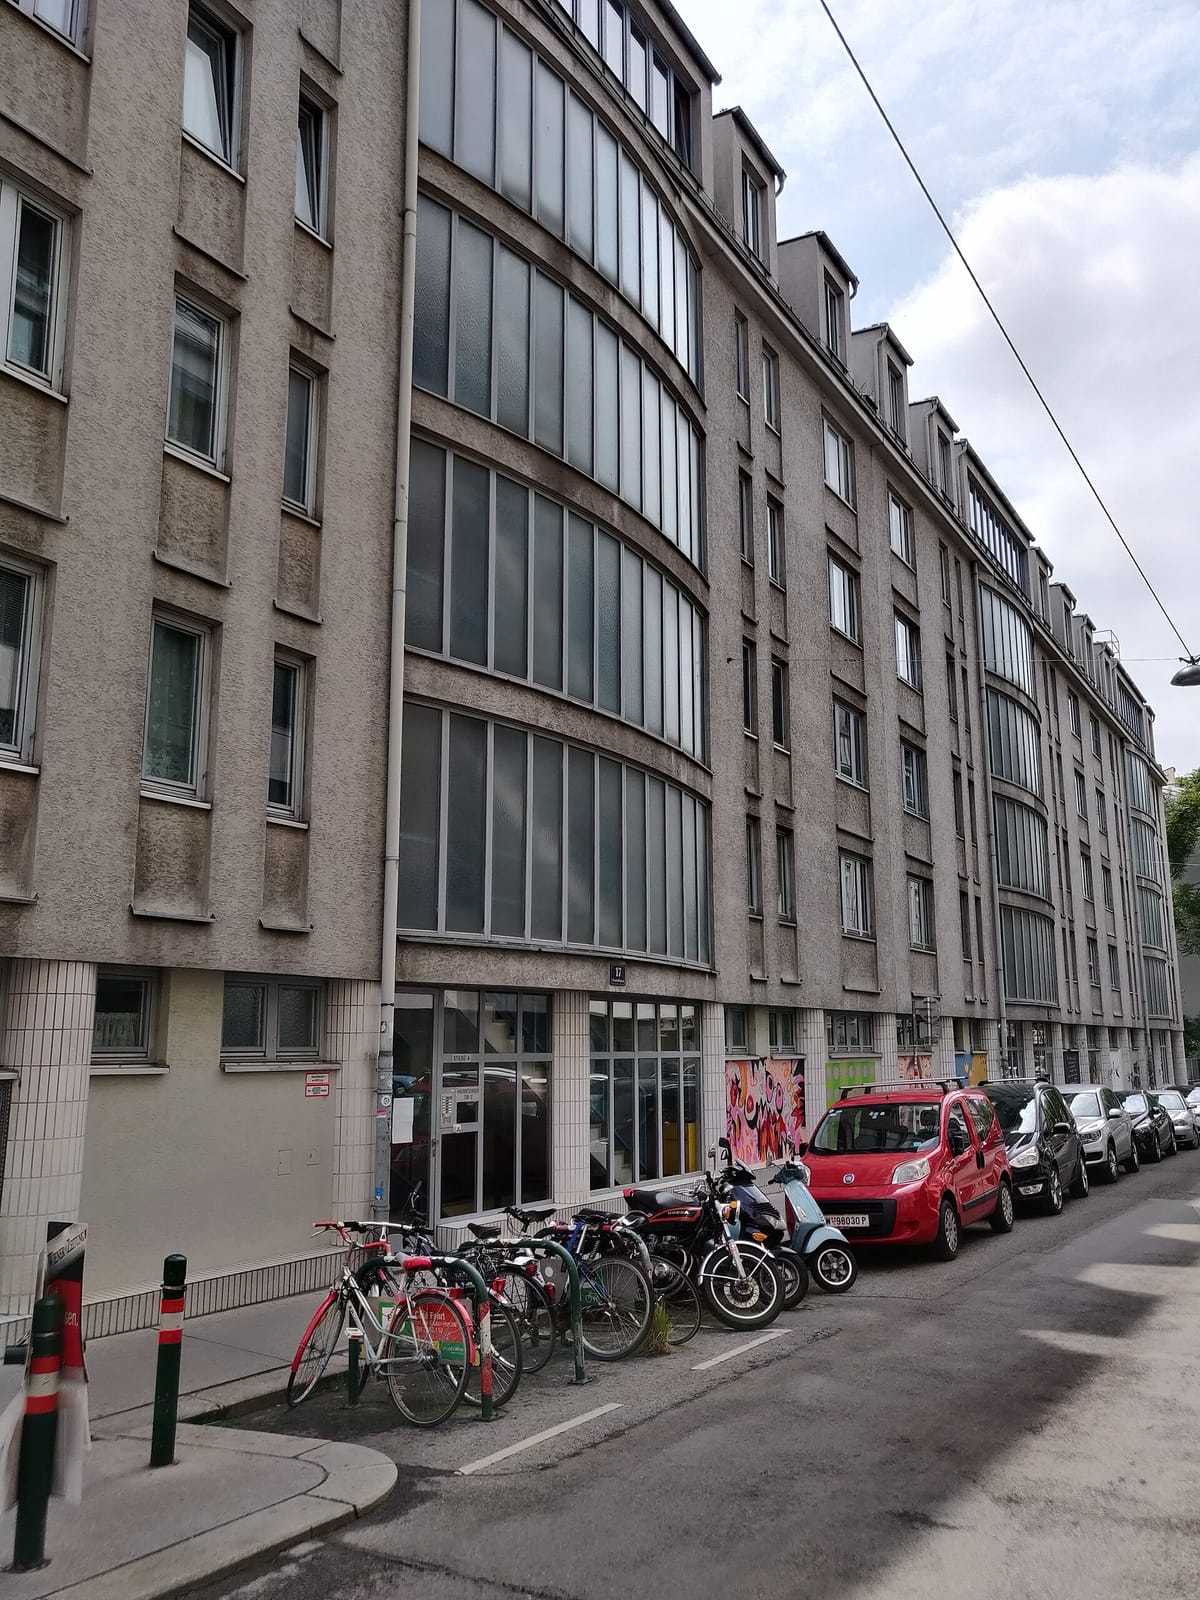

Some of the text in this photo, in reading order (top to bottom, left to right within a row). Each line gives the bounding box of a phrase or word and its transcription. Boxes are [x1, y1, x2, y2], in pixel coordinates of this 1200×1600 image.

[615, 967, 622, 977] 17
[836, 1216, 860, 1225] 98030
[861, 1216, 866, 1225] P
